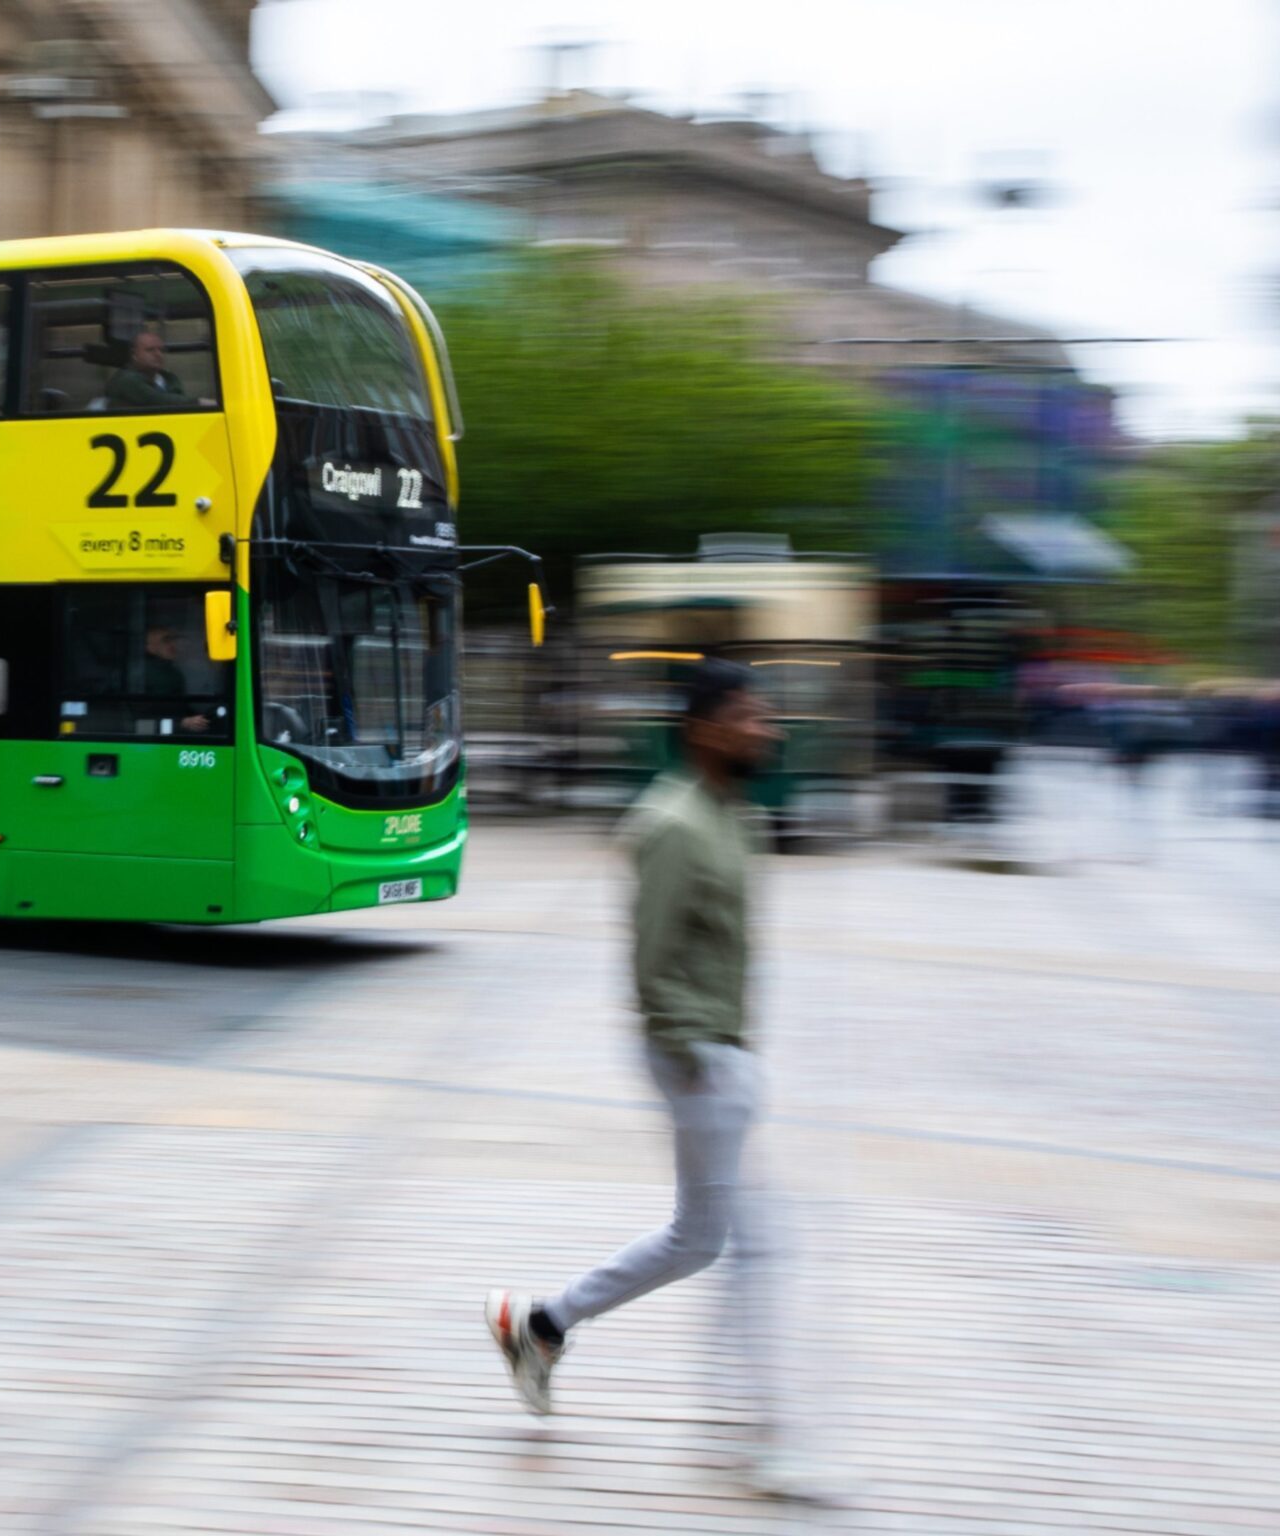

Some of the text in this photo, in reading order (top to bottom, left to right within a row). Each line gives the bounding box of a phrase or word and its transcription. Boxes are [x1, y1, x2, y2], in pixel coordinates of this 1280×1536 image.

[86, 431, 178, 508] 22
[397, 468, 423, 508] 22
[80, 530, 185, 557] every 8 mins
[179, 750, 216, 768] 8916
